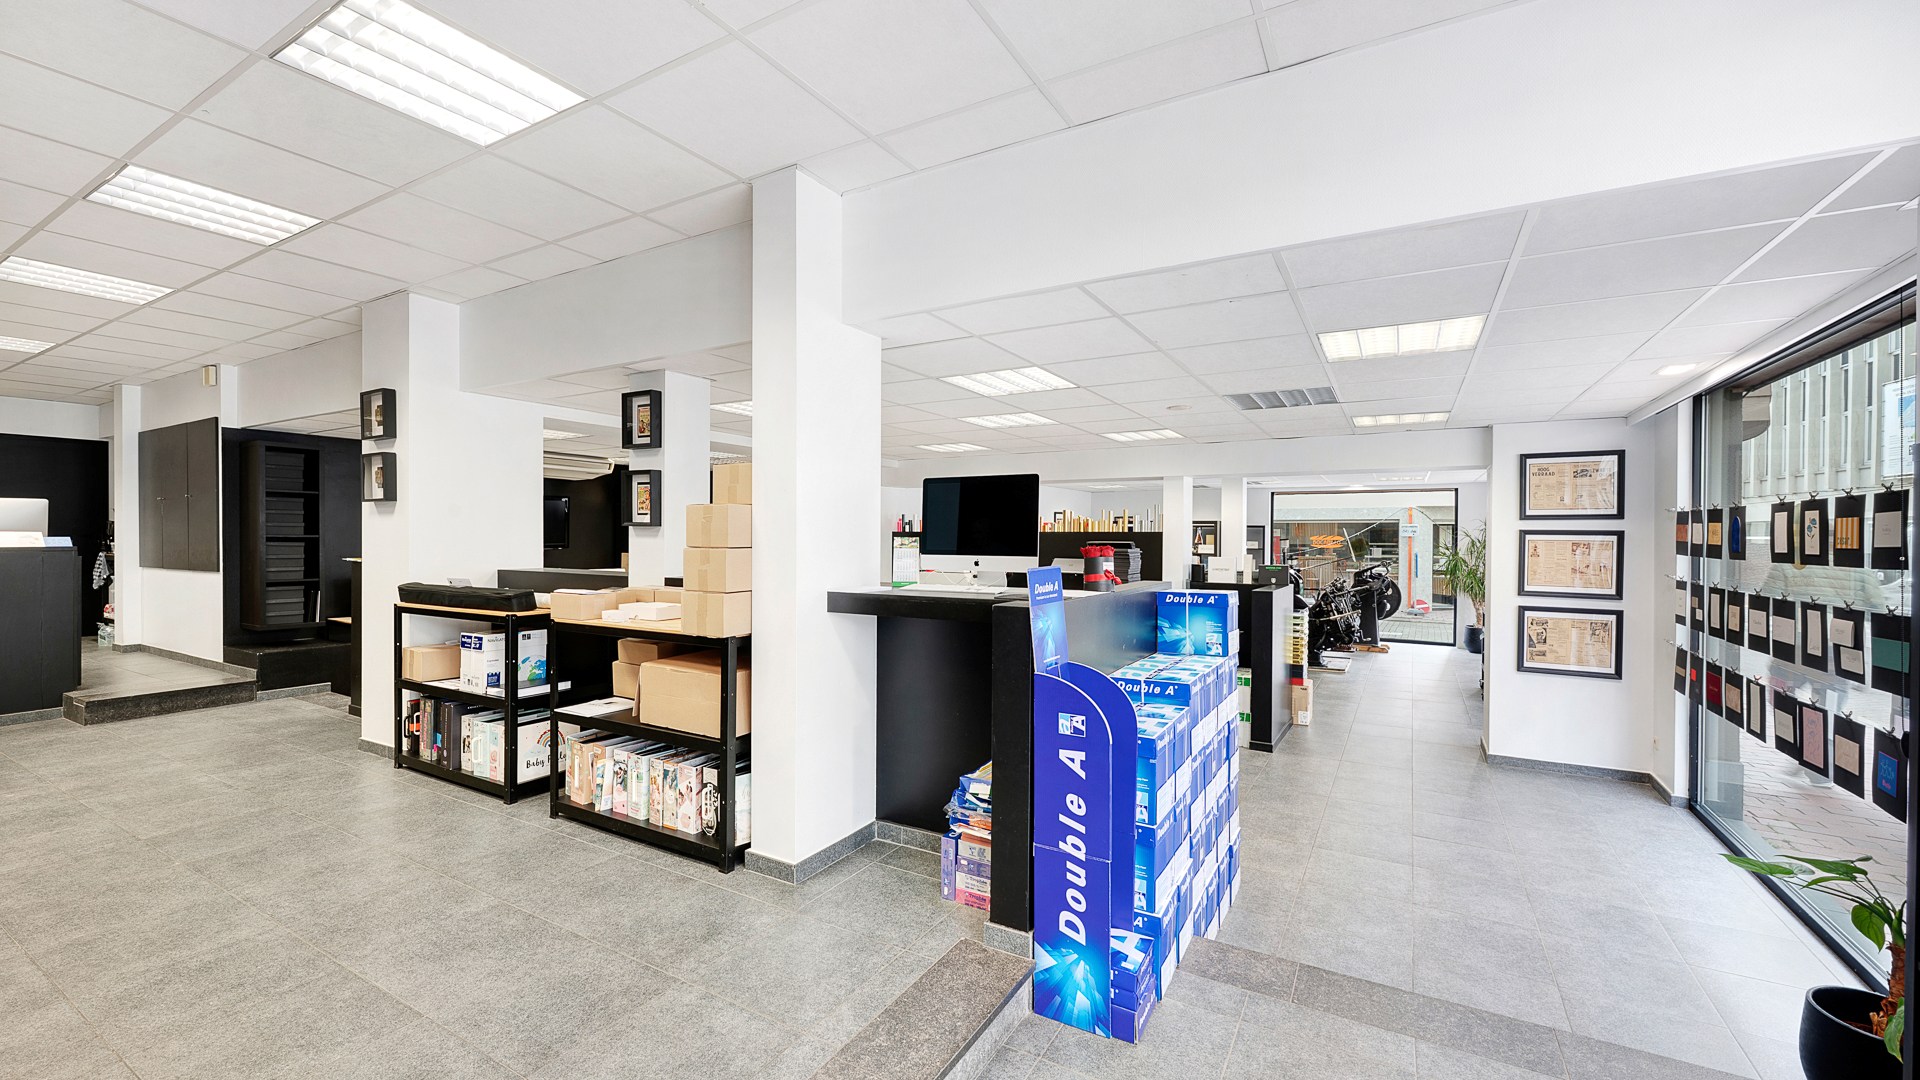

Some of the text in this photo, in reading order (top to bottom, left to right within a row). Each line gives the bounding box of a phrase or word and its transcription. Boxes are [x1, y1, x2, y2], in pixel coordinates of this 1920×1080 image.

[1034, 581, 1059, 594] Double A
[1165, 594, 1204, 604] Double
[1117, 681, 1161, 694] Double
[526, 758, 545, 769] Baby
[1058, 748, 1087, 946] Double A
